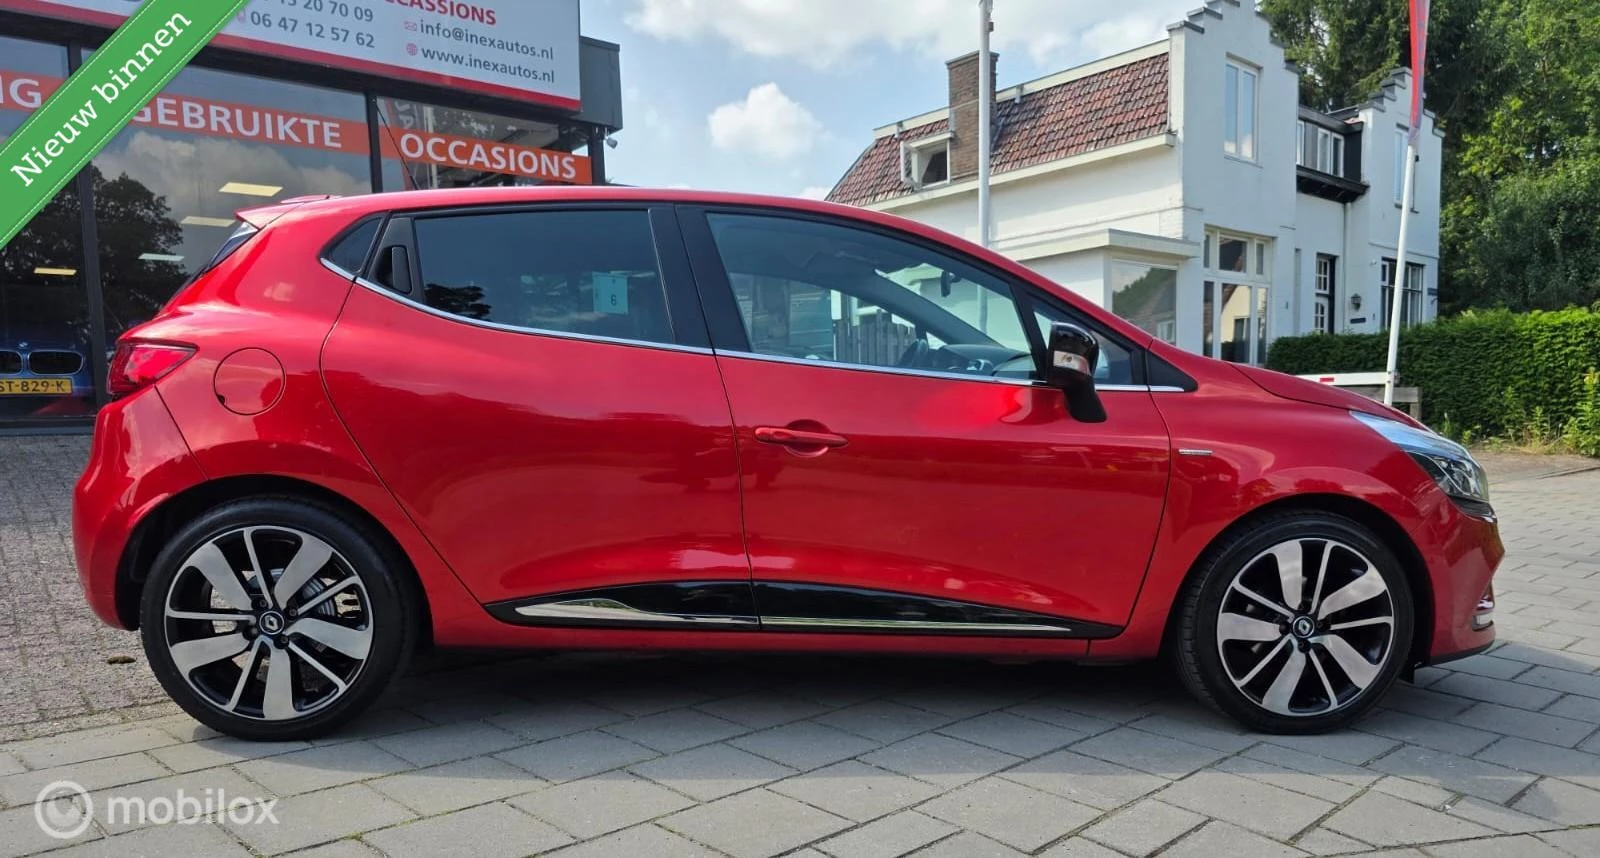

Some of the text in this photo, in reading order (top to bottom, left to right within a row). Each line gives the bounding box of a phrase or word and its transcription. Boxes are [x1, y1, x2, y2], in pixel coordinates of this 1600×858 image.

[250, 11, 375, 48] 06 47 12 57 62
[329, 1, 349, 17] 70
[353, 6, 374, 22] 09
[420, 19, 554, 61] info@inexautos.nl
[421, 47, 555, 83] www.inexautos.nl
[0, 74, 42, 108] G
[400, 133, 577, 180] OCCASIONS
